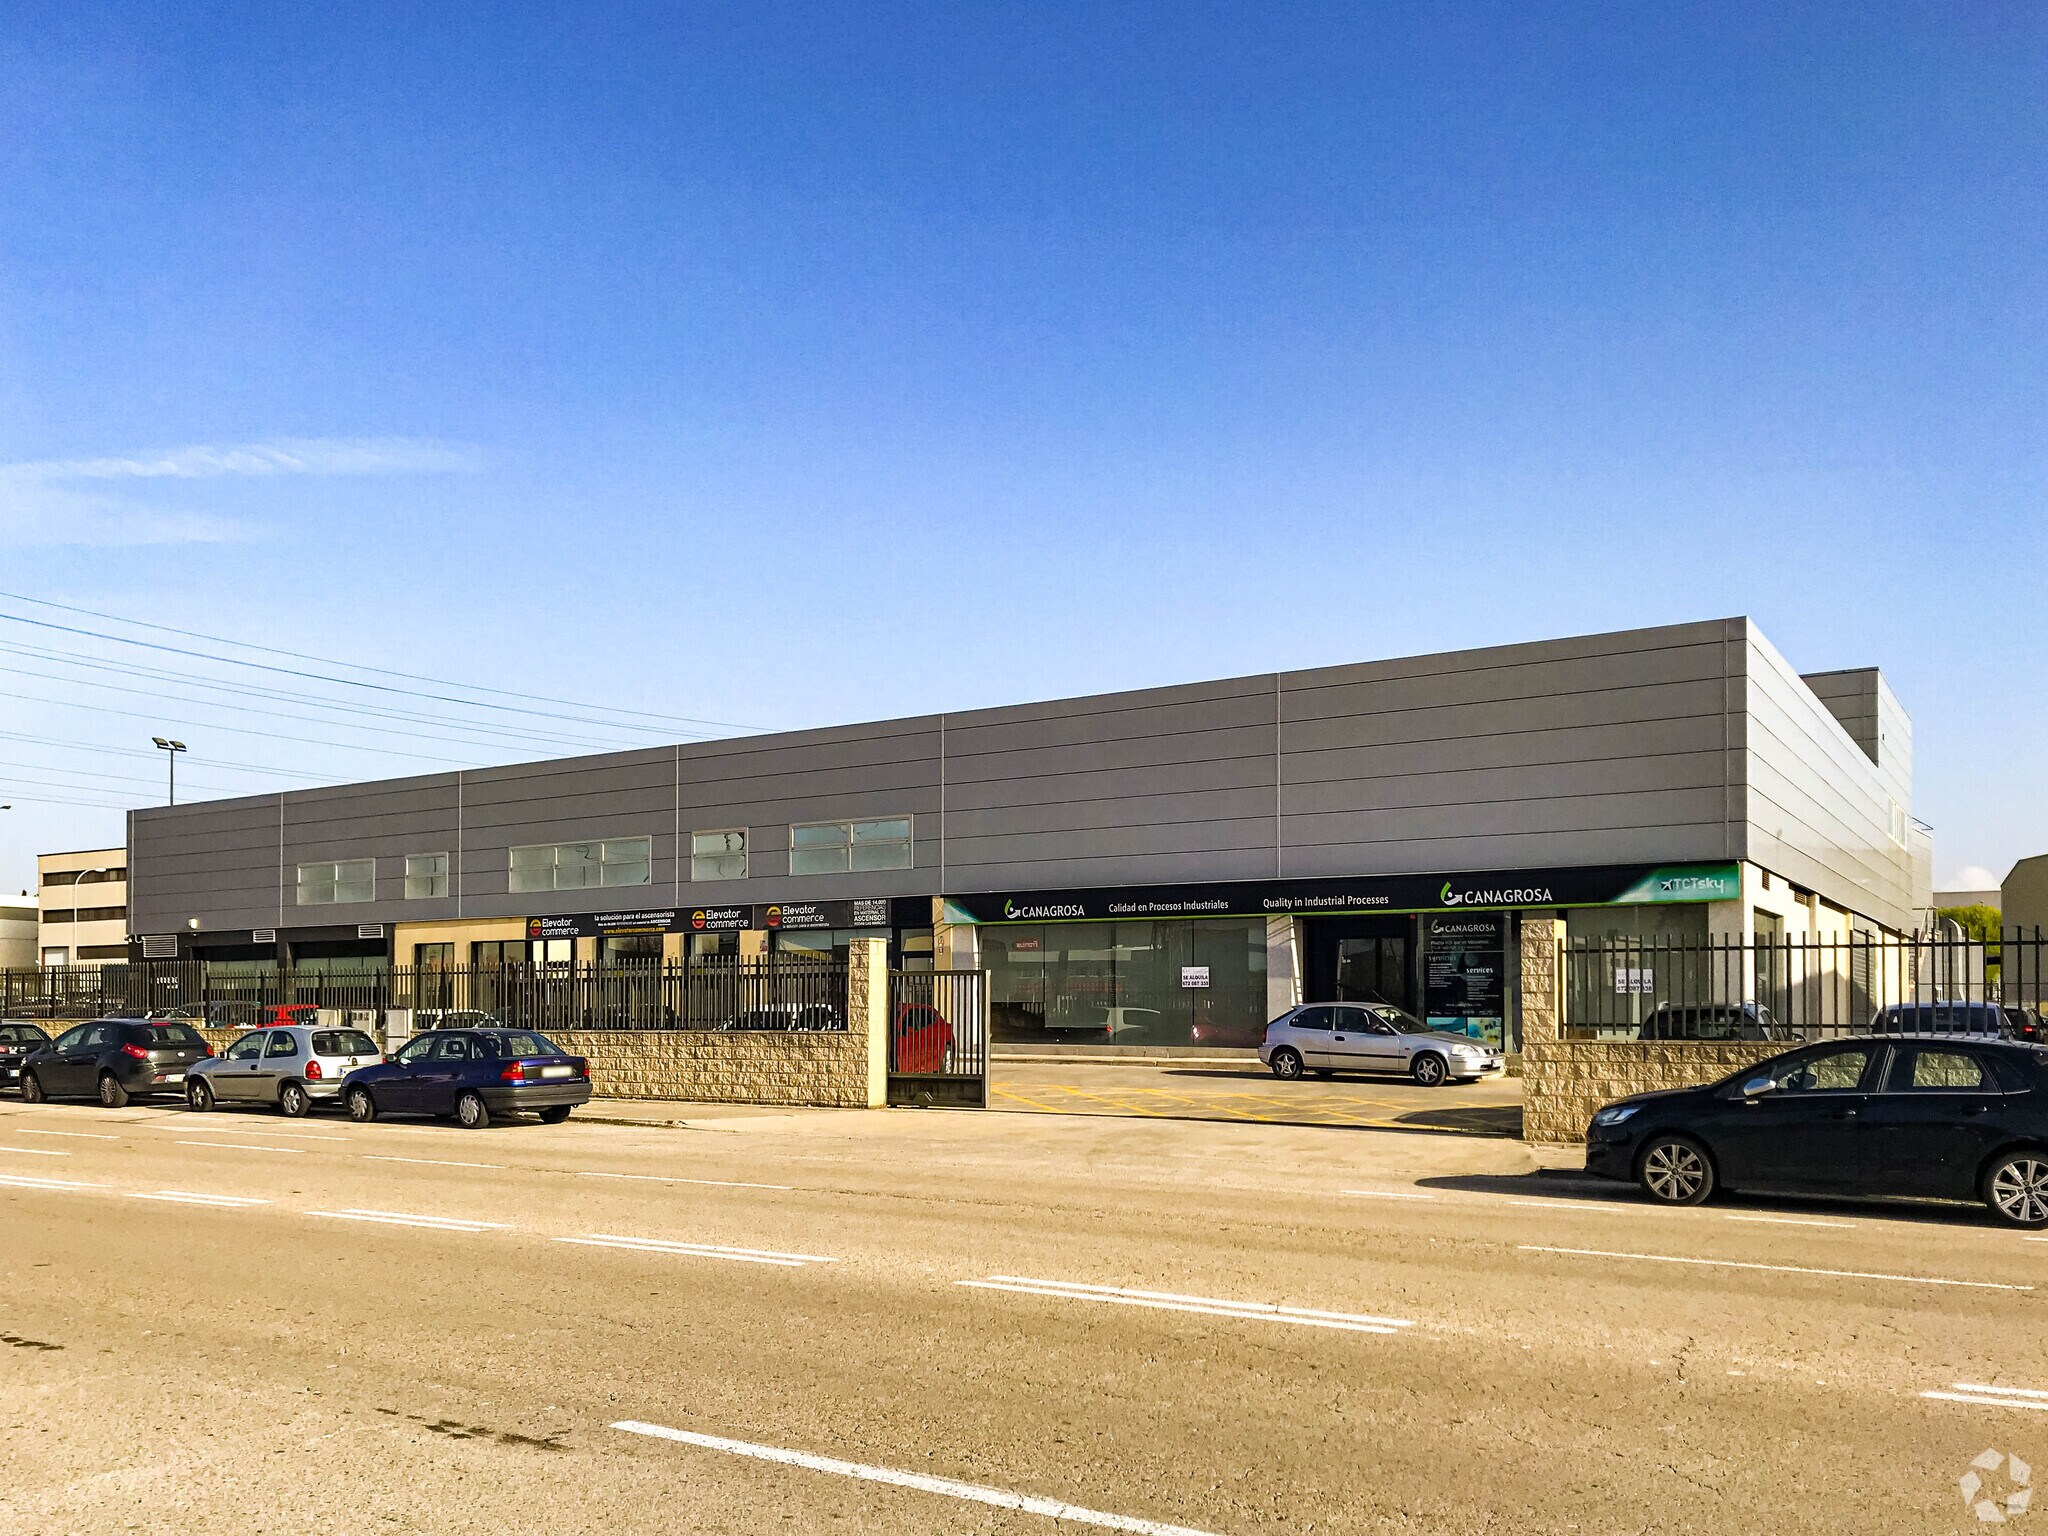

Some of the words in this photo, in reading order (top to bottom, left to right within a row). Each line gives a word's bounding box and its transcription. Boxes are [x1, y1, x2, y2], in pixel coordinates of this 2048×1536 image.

[1464, 888, 1552, 904] CANAGROSA
[1108, 903, 1136, 912] Calidad
[1149, 902, 1182, 911] Procesos
[1184, 900, 1228, 910] Industriales
[1263, 898, 1292, 909] Quality
[1294, 898, 1303, 906] in
[1305, 896, 1345, 906] Industrial
[1348, 895, 1389, 904] Processes
[706, 909, 741, 920] Elevator
[782, 905, 816, 914] Elevator
[1022, 905, 1085, 918] CANAGROSA
[542, 918, 572, 927] Elevator
[706, 920, 748, 928] commerce
[782, 915, 824, 923] commerce
[1445, 924, 1496, 932] CANAGROSA
